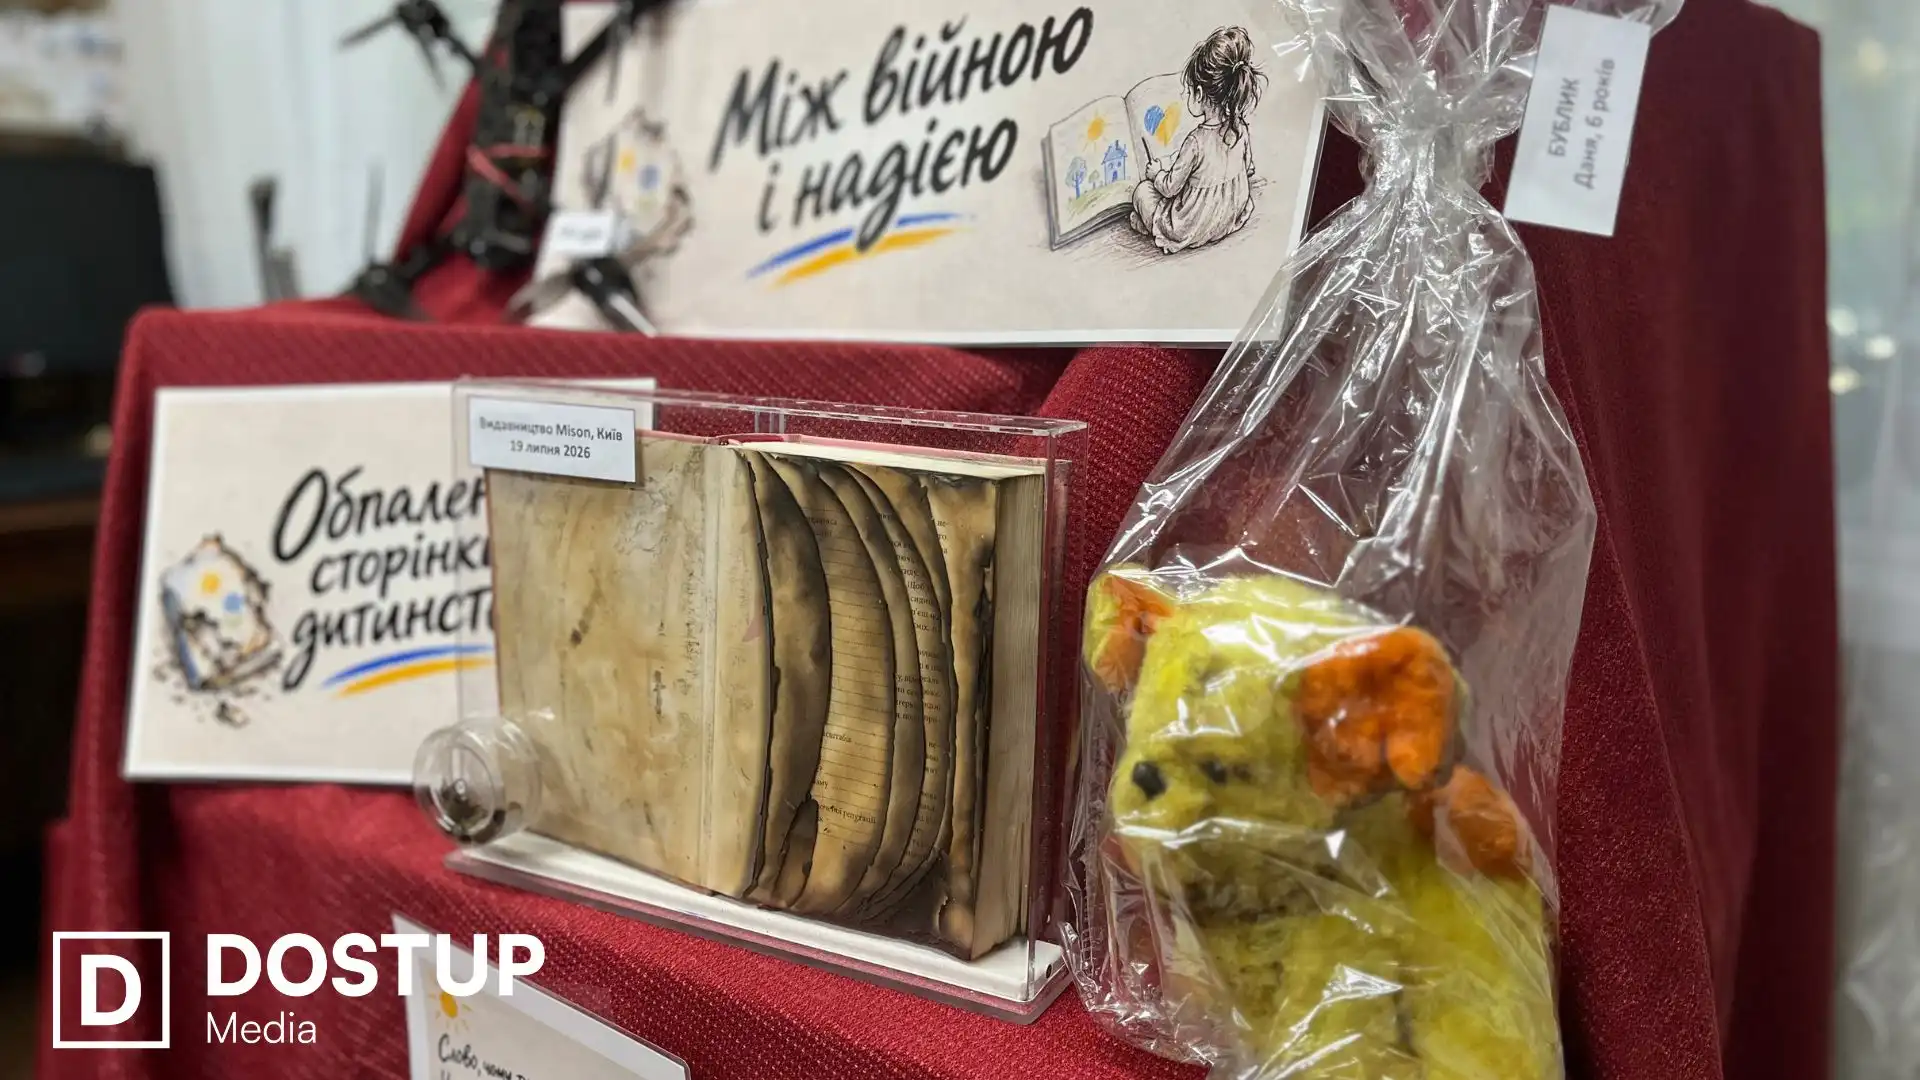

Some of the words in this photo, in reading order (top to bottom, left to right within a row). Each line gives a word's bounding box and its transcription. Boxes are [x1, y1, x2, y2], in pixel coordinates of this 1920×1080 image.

[709, 58, 850, 172] Між
[863, 6, 1094, 126] війною
[1593, 58, 1615, 113] років
[1548, 77, 1580, 158] БУБЛИК
[1584, 115, 1604, 128] 6
[756, 149, 781, 233] і
[791, 118, 1018, 254] надією
[1573, 134, 1604, 190] Даня,
[479, 416, 553, 436] Видавництво
[555, 423, 595, 441] Mison,
[596, 427, 623, 442] Київ
[510, 440, 524, 453] 19
[525, 443, 560, 456] липня
[563, 444, 591, 459] 2026
[281, 586, 494, 692] дитинст
